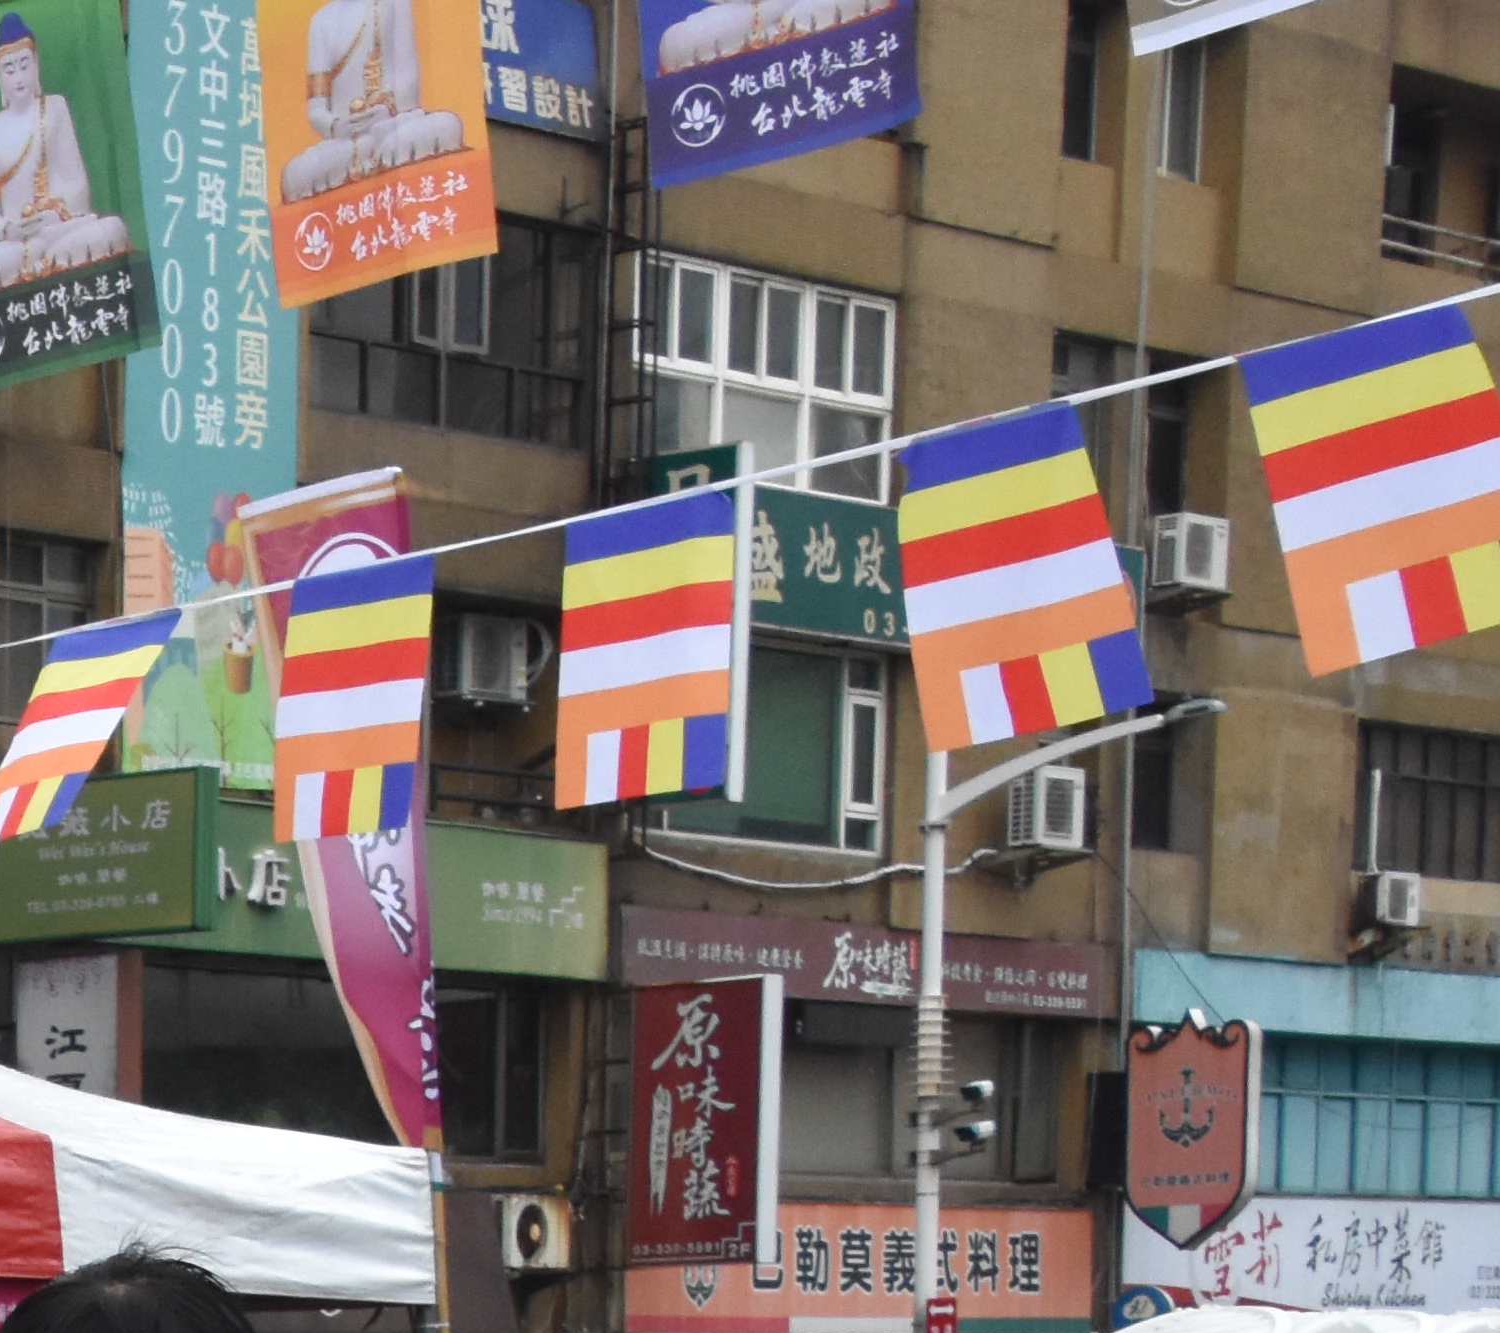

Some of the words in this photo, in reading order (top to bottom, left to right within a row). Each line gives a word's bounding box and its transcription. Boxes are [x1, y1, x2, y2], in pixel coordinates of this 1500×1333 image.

[729, 31, 900, 100] 桃園佛教蓮社
